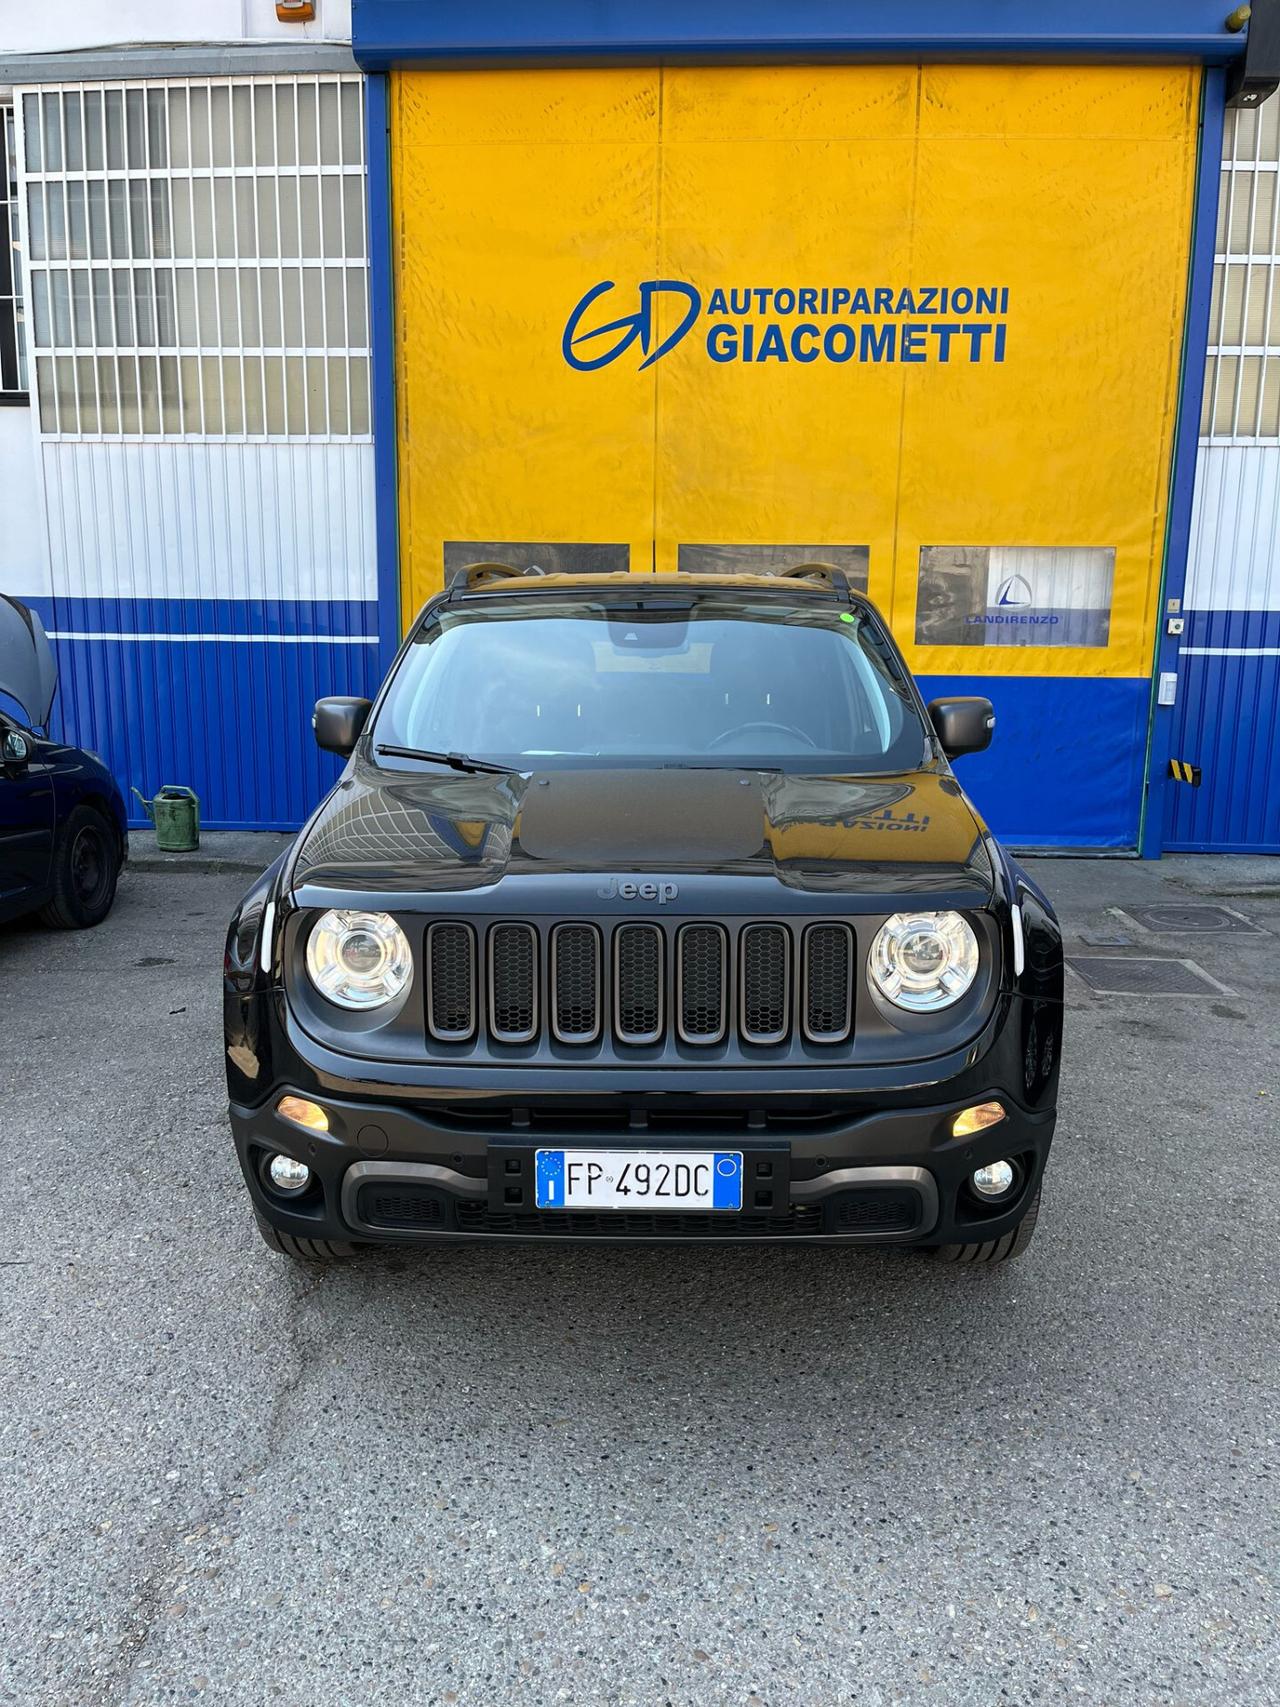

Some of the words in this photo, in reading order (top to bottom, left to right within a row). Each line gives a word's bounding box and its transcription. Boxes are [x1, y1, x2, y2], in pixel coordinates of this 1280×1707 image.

[706, 287, 1010, 315] AUTORIPARAZIONI
[705, 323, 1008, 363] GIACOMETTI
[597, 877, 679, 905] Jeep
[567, 1163, 603, 1196] FP
[616, 1163, 710, 1197] 492DC
